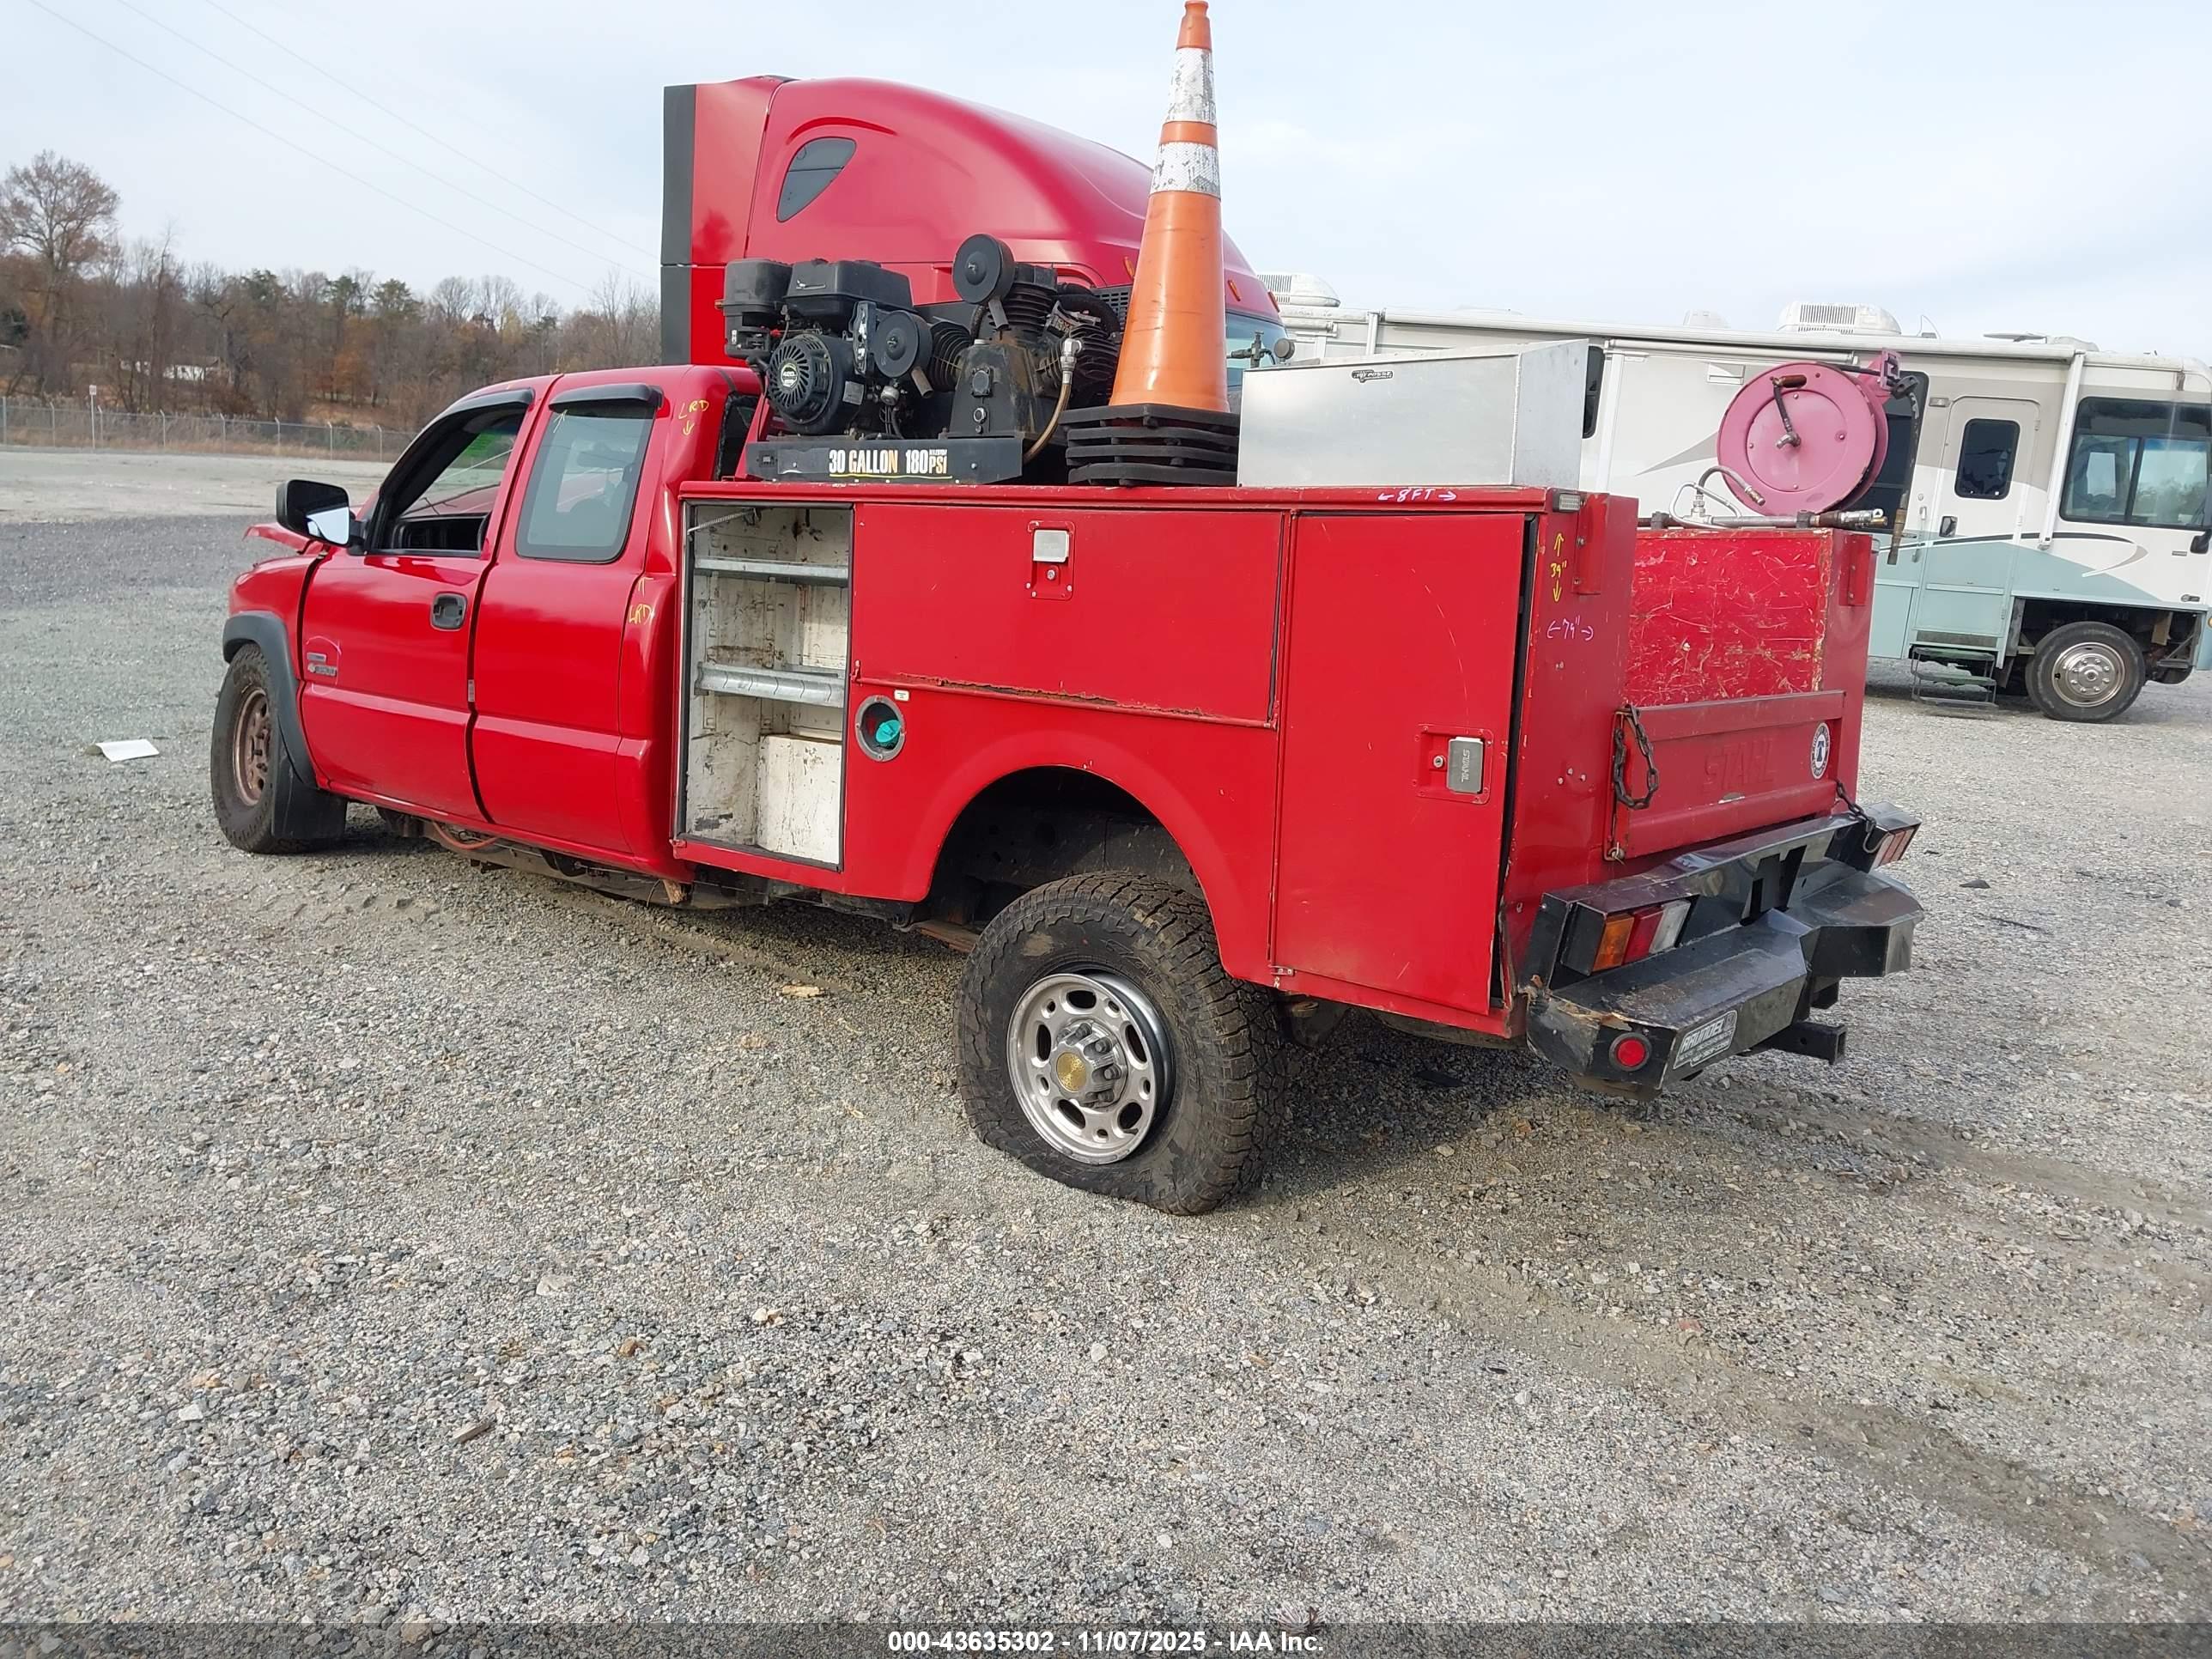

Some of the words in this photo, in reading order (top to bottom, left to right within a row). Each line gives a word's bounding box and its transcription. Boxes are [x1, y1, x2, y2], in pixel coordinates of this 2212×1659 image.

[678, 399, 709, 419] LRD
[829, 449, 846, 473] 30
[848, 449, 898, 474] GALLON
[906, 449, 928, 474] 180
[929, 456, 947, 474] PSI
[629, 603, 653, 625] LRD
